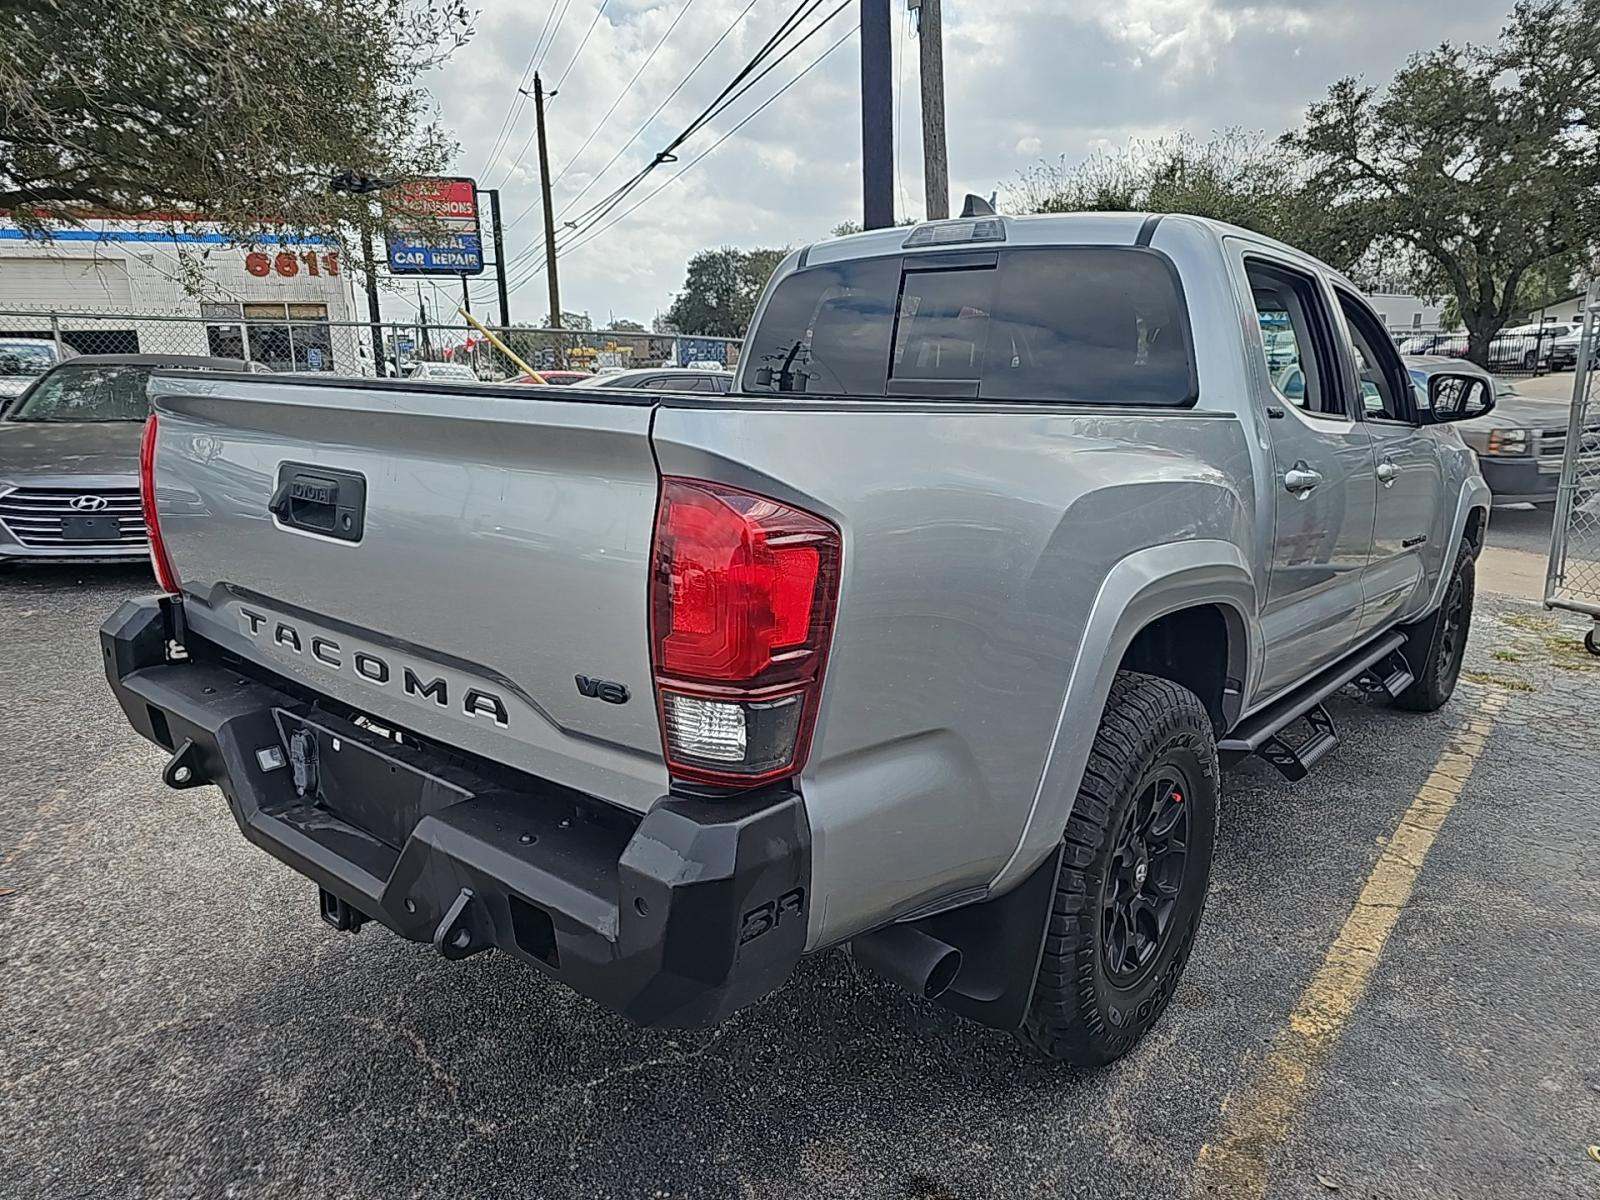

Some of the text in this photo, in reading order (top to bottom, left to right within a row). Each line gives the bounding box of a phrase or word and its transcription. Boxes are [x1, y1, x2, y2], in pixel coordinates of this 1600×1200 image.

[404, 235, 466, 250] GENRAL
[245, 250, 340, 277] 6611
[394, 252, 478, 266] CAR REPAIR
[292, 482, 329, 503] TOYOTA
[239, 606, 510, 729] TACOMA
[574, 673, 630, 705] V6
